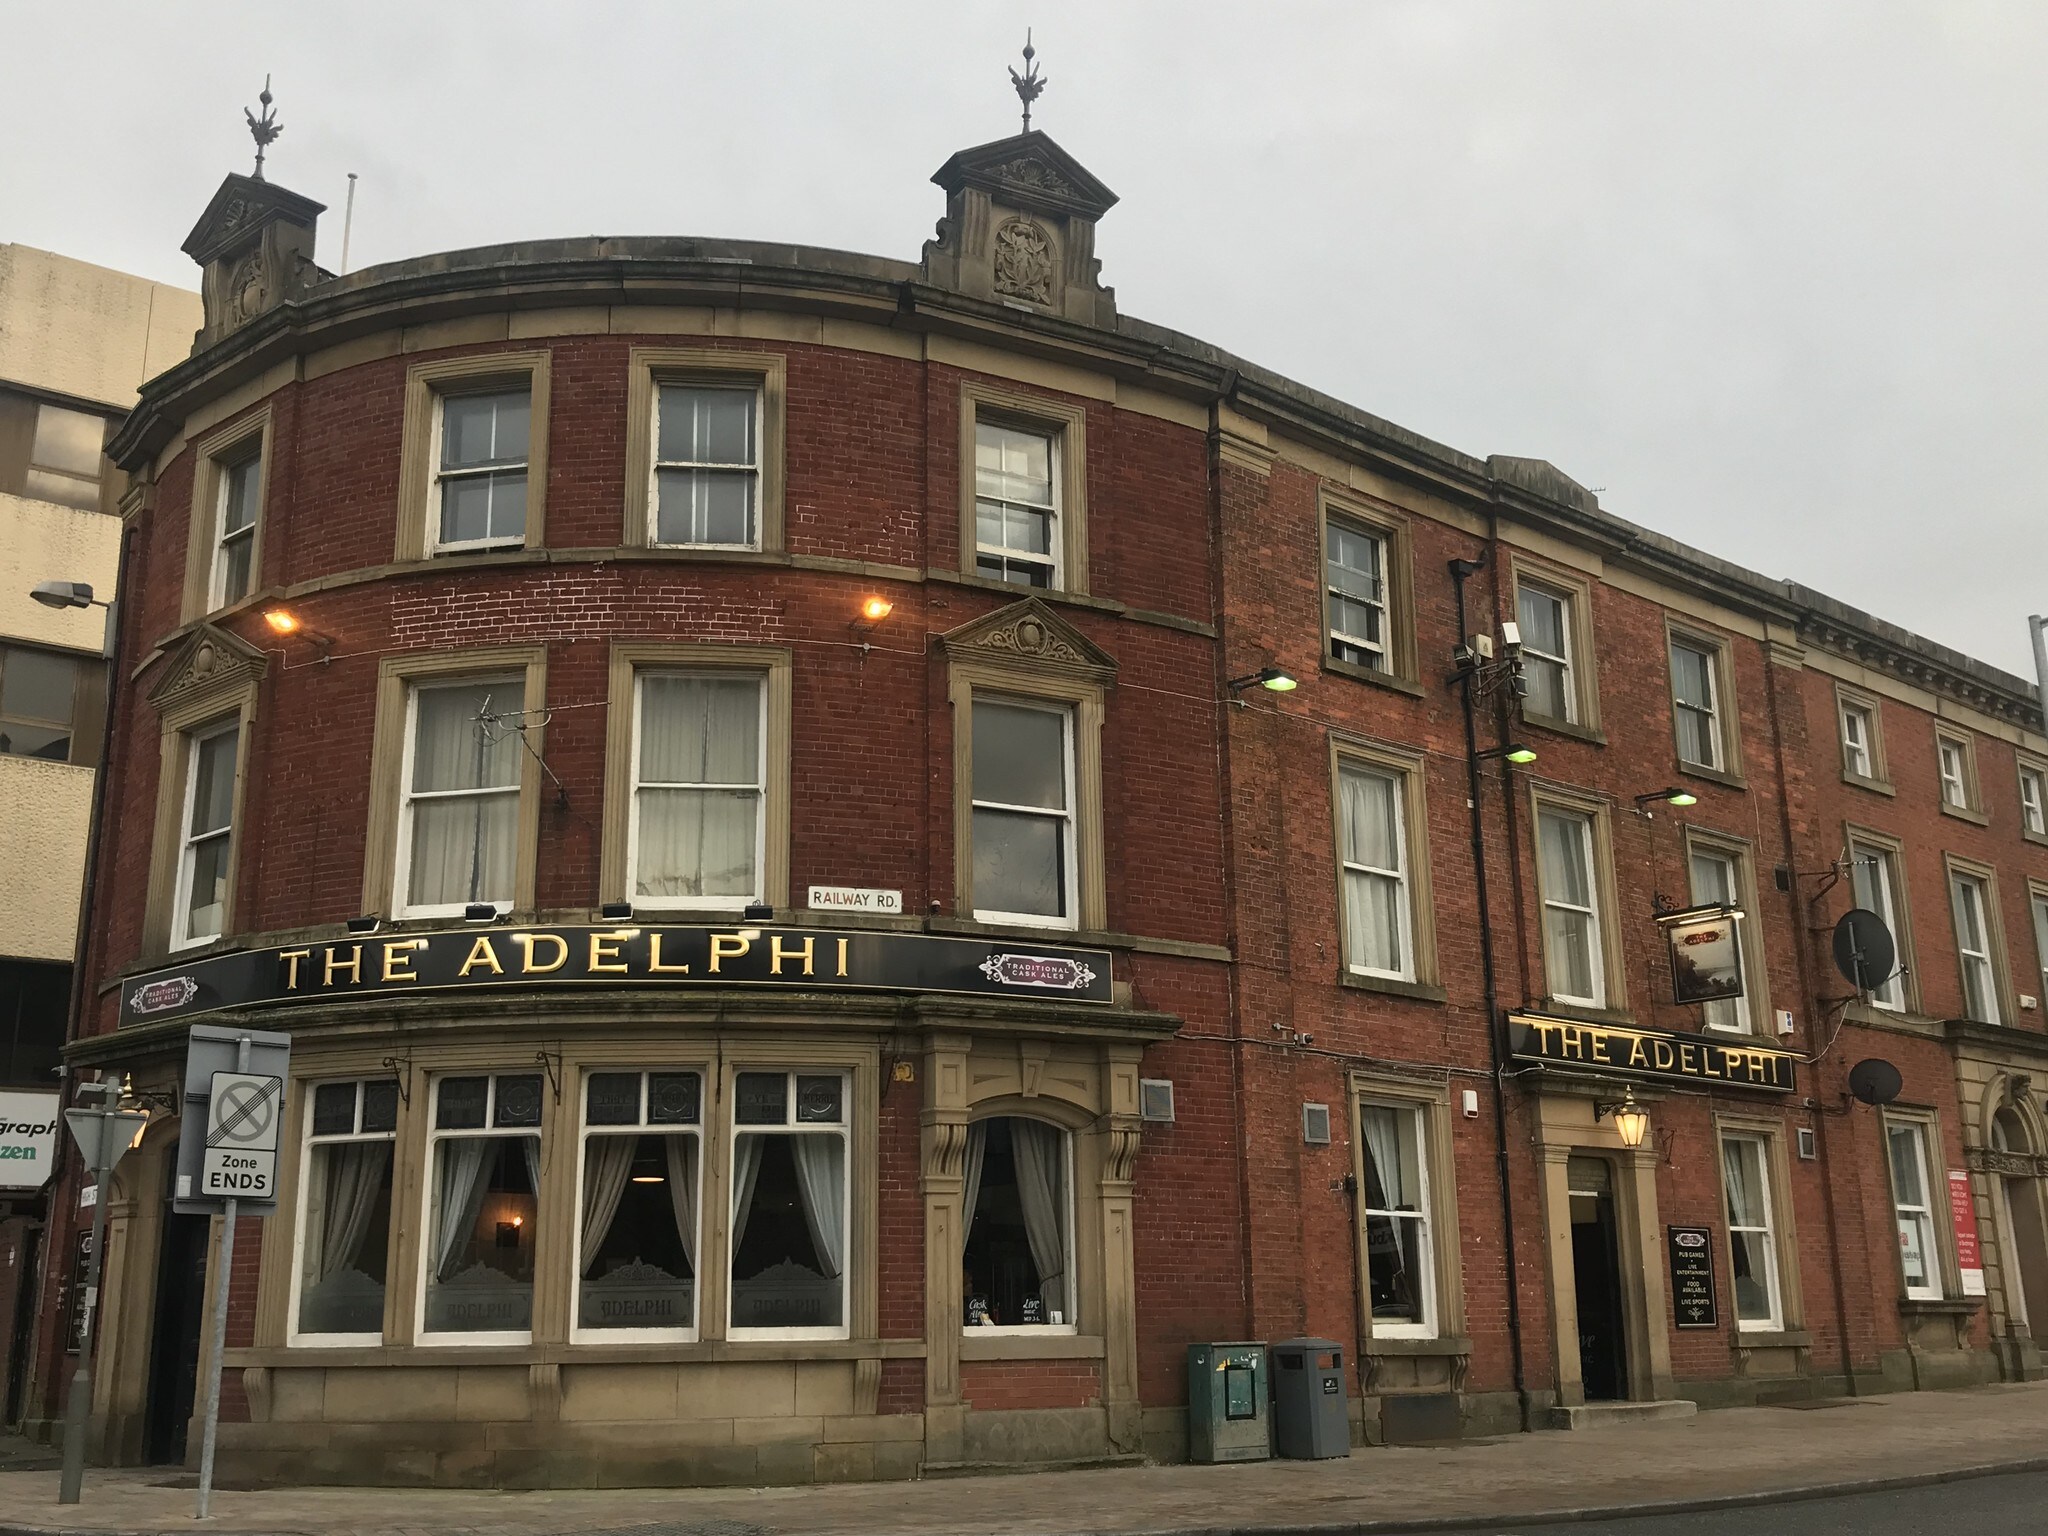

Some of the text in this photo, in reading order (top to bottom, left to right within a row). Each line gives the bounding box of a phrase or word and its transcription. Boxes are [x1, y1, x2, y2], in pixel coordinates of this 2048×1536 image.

[813, 891, 898, 908] RAILWAY RD.
[279, 933, 849, 990] THE ADELPHI
[1006, 962, 1070, 974] TRADITIONAL
[1012, 970, 1065, 980] CASK ALES
[145, 986, 183, 998] TRADITIONAL
[147, 993, 179, 1004] CASK ALES
[1533, 1024, 1778, 1084] THE ADELPHI
[222, 1155, 257, 1169] Zone
[210, 1172, 266, 1190] ENDS
[1689, 1251, 1705, 1259] GAMES
[601, 1298, 673, 1318] ADELPHI
[969, 1298, 988, 1310] Cask
[1022, 1298, 1041, 1309] Live
